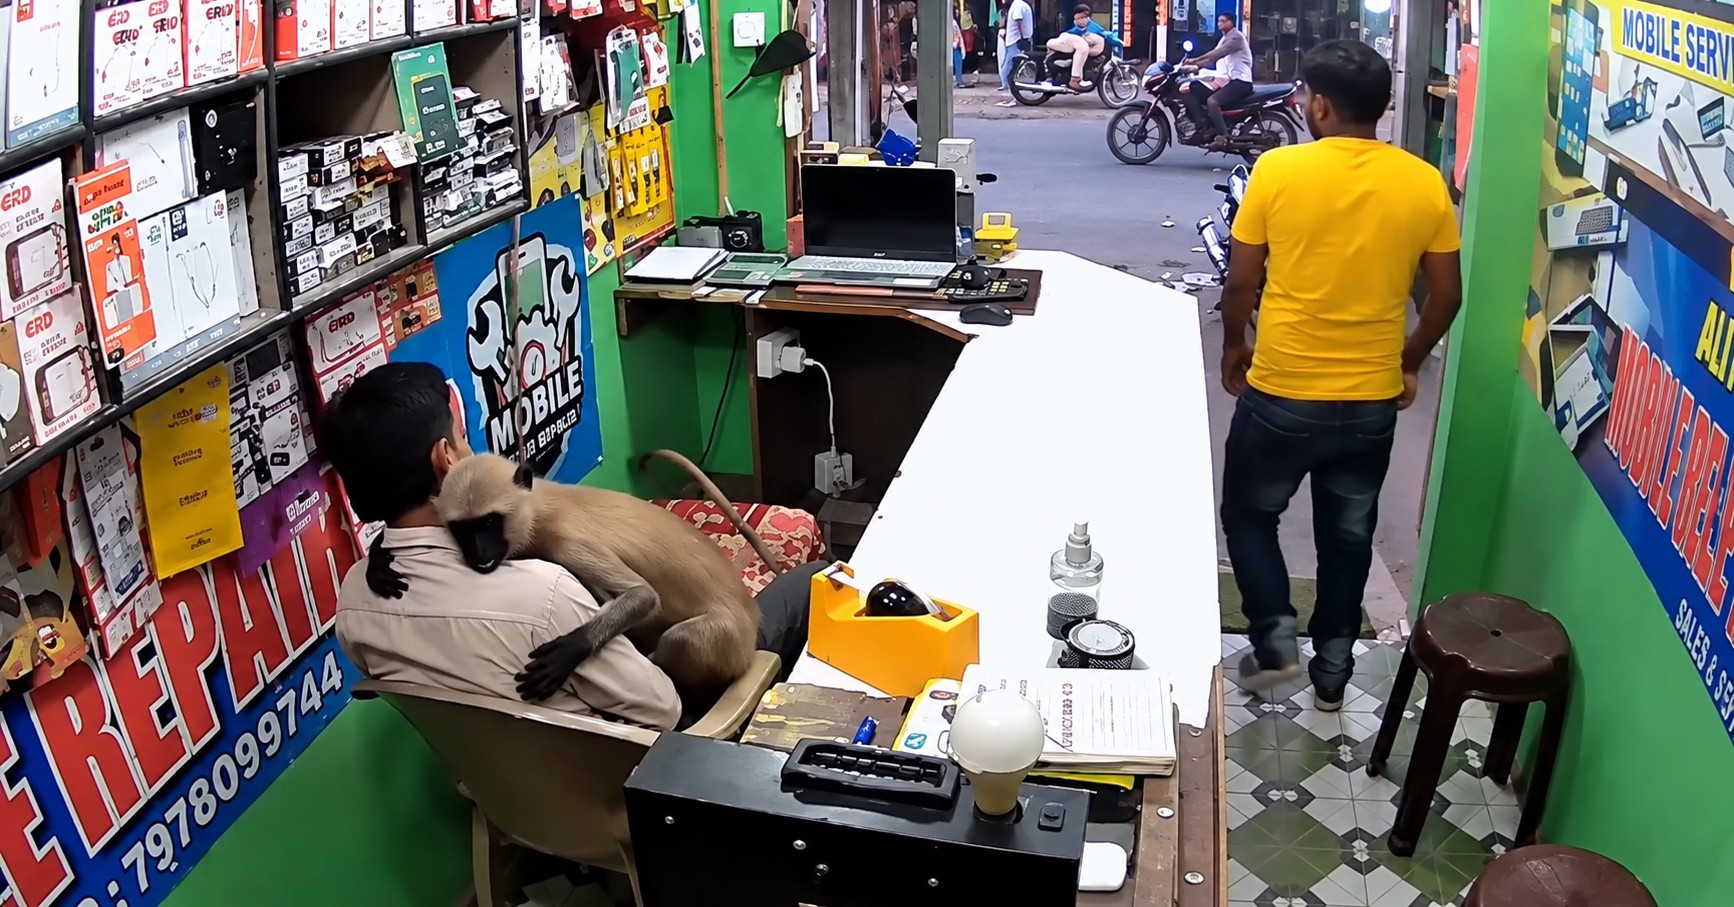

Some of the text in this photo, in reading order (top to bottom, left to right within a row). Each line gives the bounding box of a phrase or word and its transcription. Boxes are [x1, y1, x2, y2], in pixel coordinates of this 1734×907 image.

[1622, 7, 1681, 64] MOBILE
[0, 185, 32, 213] ERD
[25, 311, 54, 338] ERD
[490, 360, 582, 456] MOBILE
[1604, 321, 1694, 531] MOBILE
[1675, 598, 1710, 671] SALES
[1705, 654, 1718, 687] &
[121, 650, 343, 894] 7978099744
